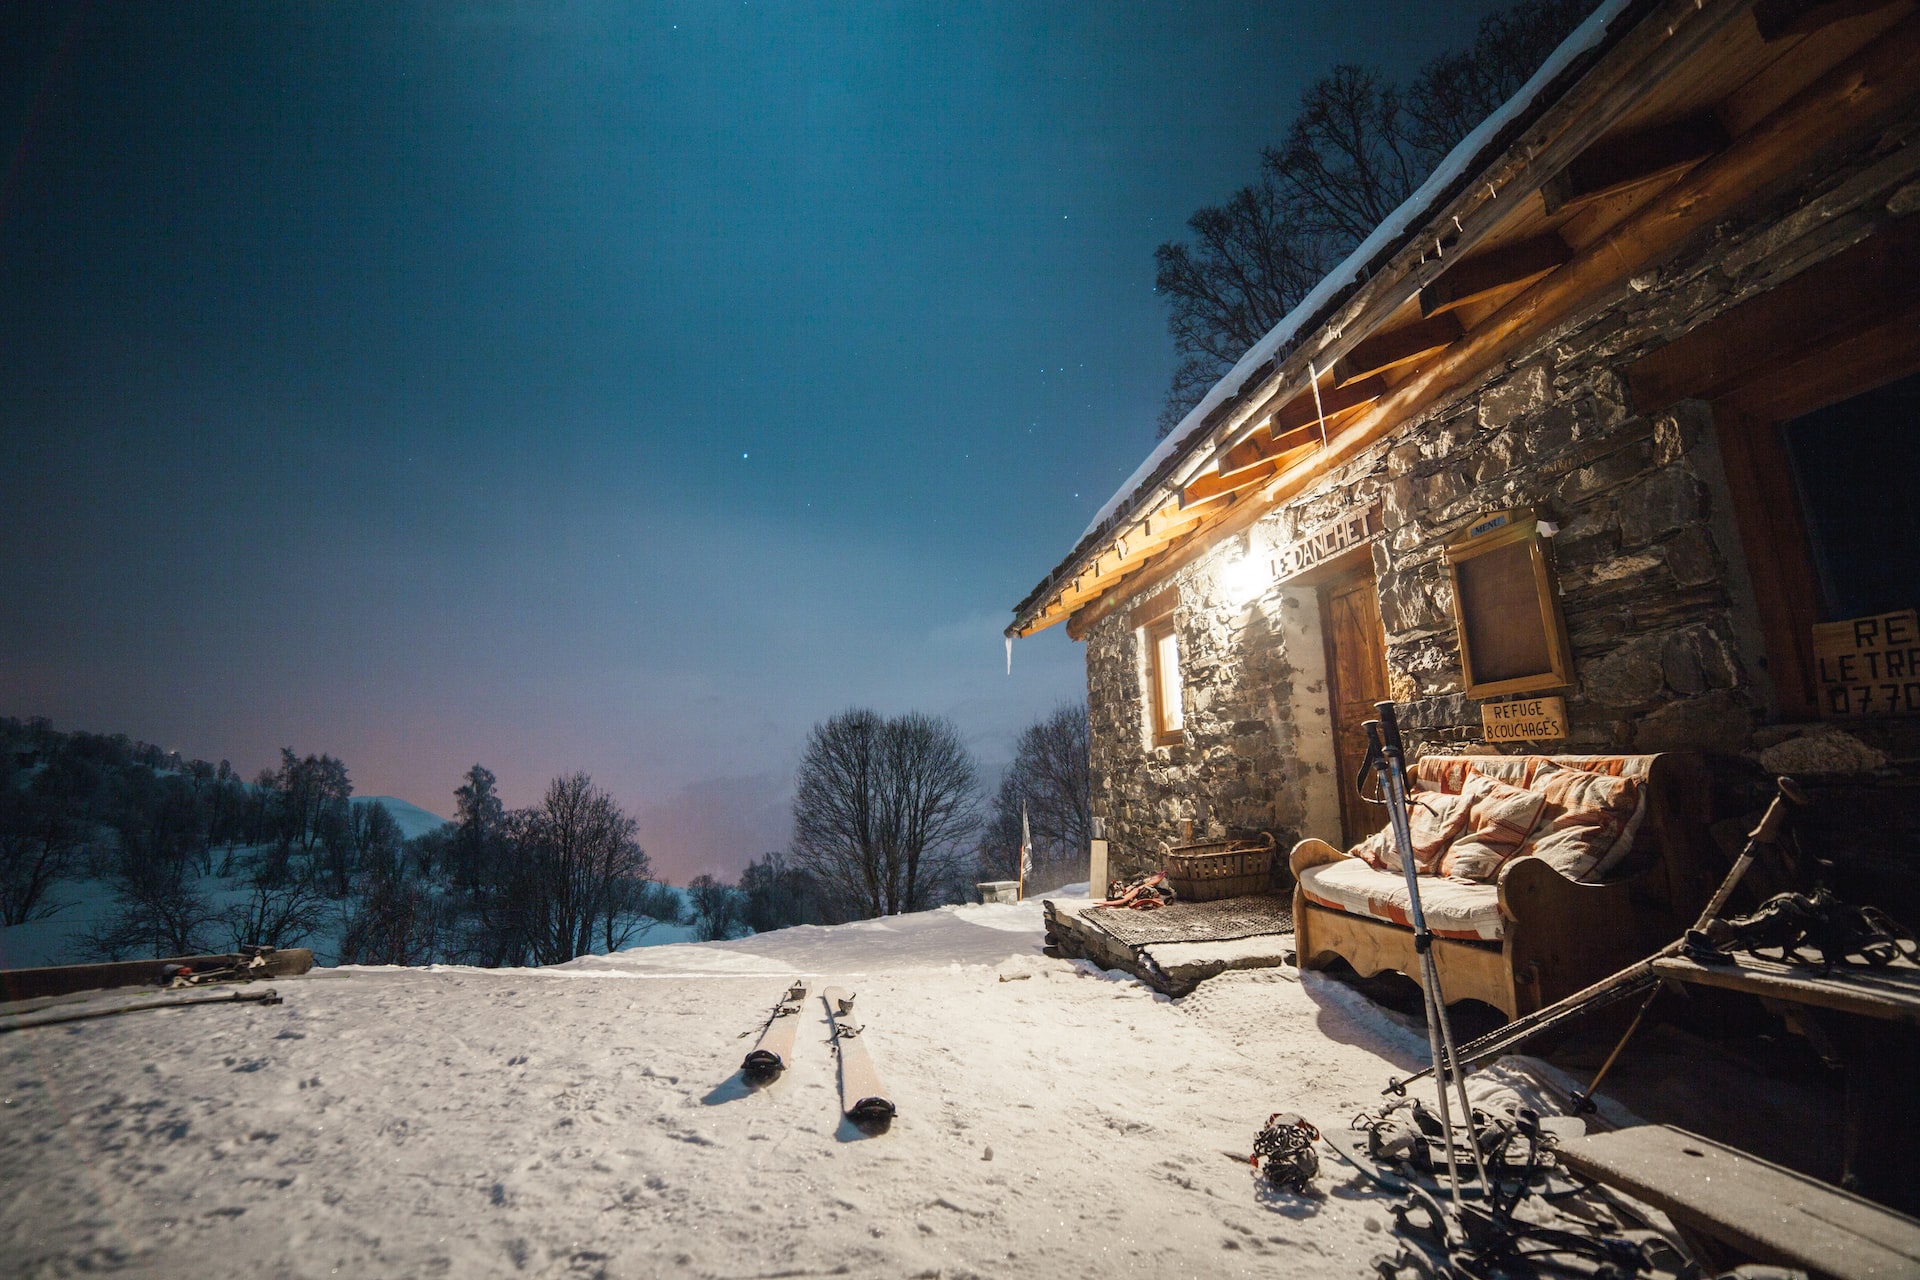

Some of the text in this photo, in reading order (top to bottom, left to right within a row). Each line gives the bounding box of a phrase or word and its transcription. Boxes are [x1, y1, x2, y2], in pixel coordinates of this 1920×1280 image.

[1475, 517, 1500, 534] MENU
[1269, 508, 1371, 579] LE DANCHET
[1494, 701, 1544, 718] REFUGE
